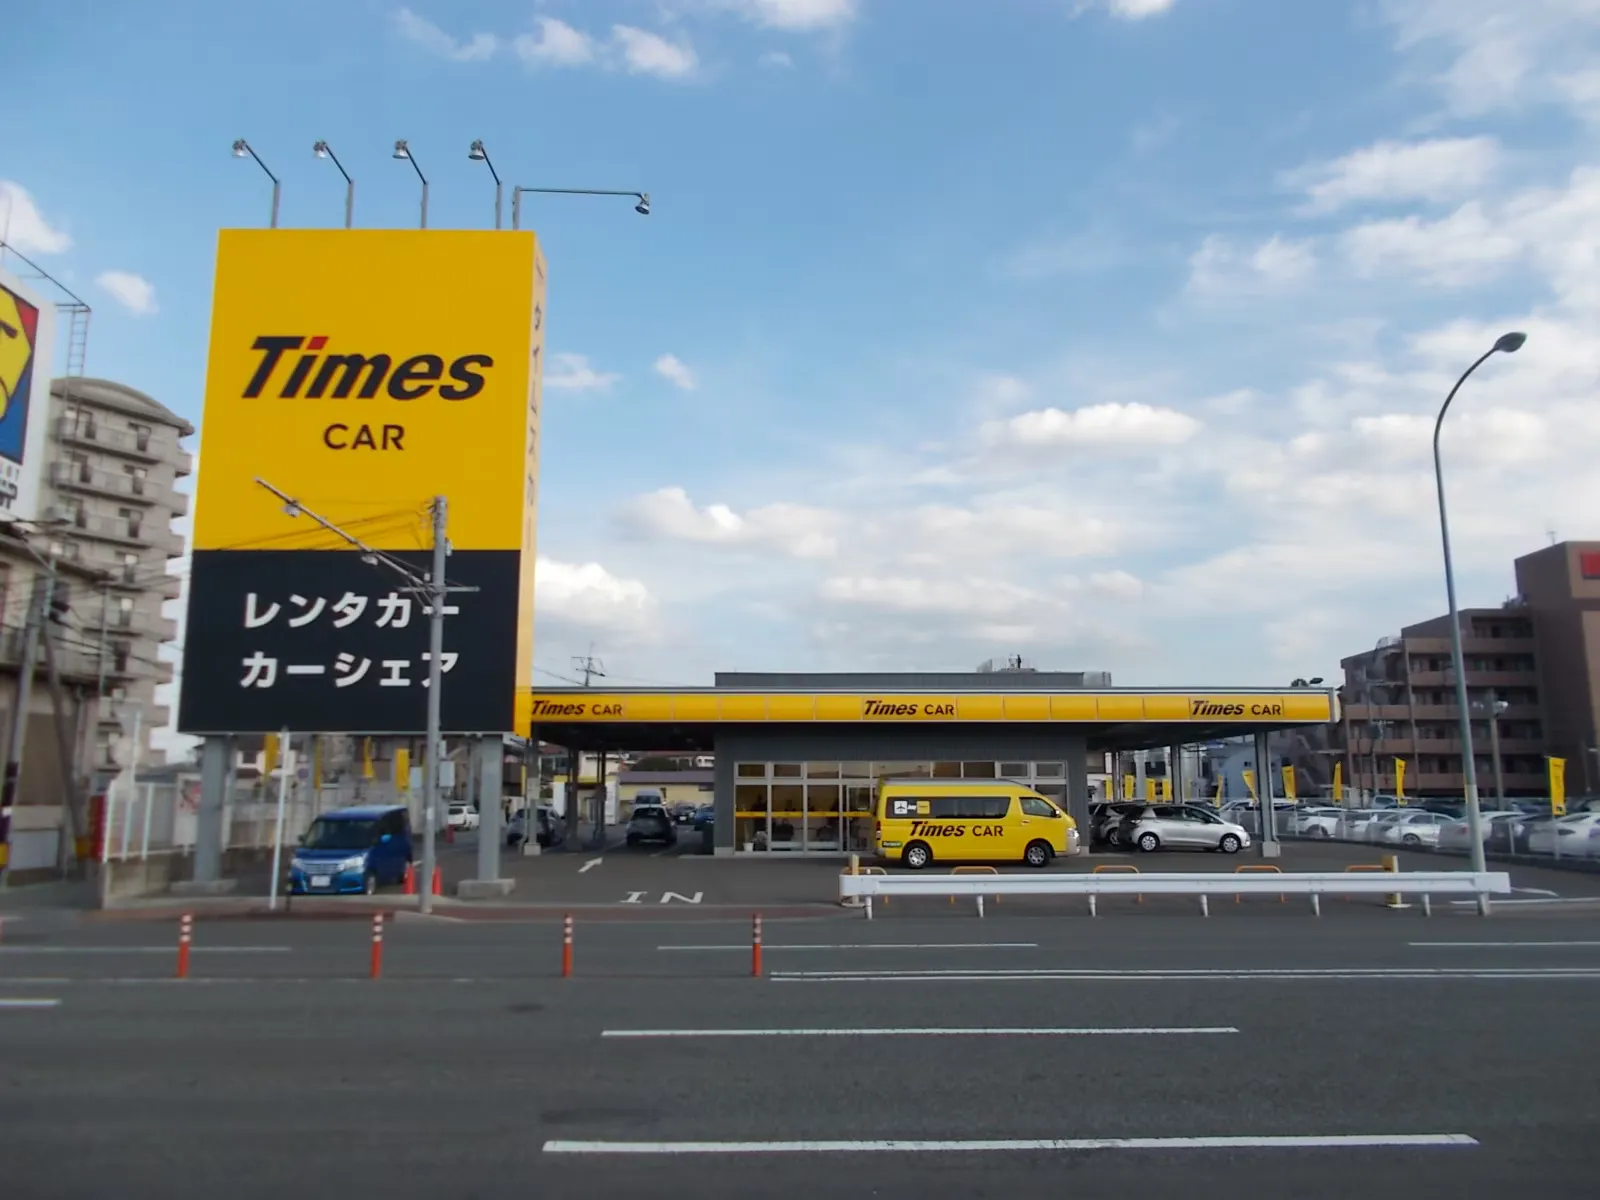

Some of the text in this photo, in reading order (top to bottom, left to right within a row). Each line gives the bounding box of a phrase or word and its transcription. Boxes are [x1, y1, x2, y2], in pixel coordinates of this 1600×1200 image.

[241, 335, 494, 401] Times
[323, 423, 405, 450] CAR
[244, 592, 460, 629] レンタカー
[240, 651, 459, 688] カーシェア
[532, 700, 623, 715] Times CAR
[865, 700, 955, 715] Times CAR
[1192, 700, 1282, 715] Times CAR
[910, 821, 1004, 837] Times CAR
